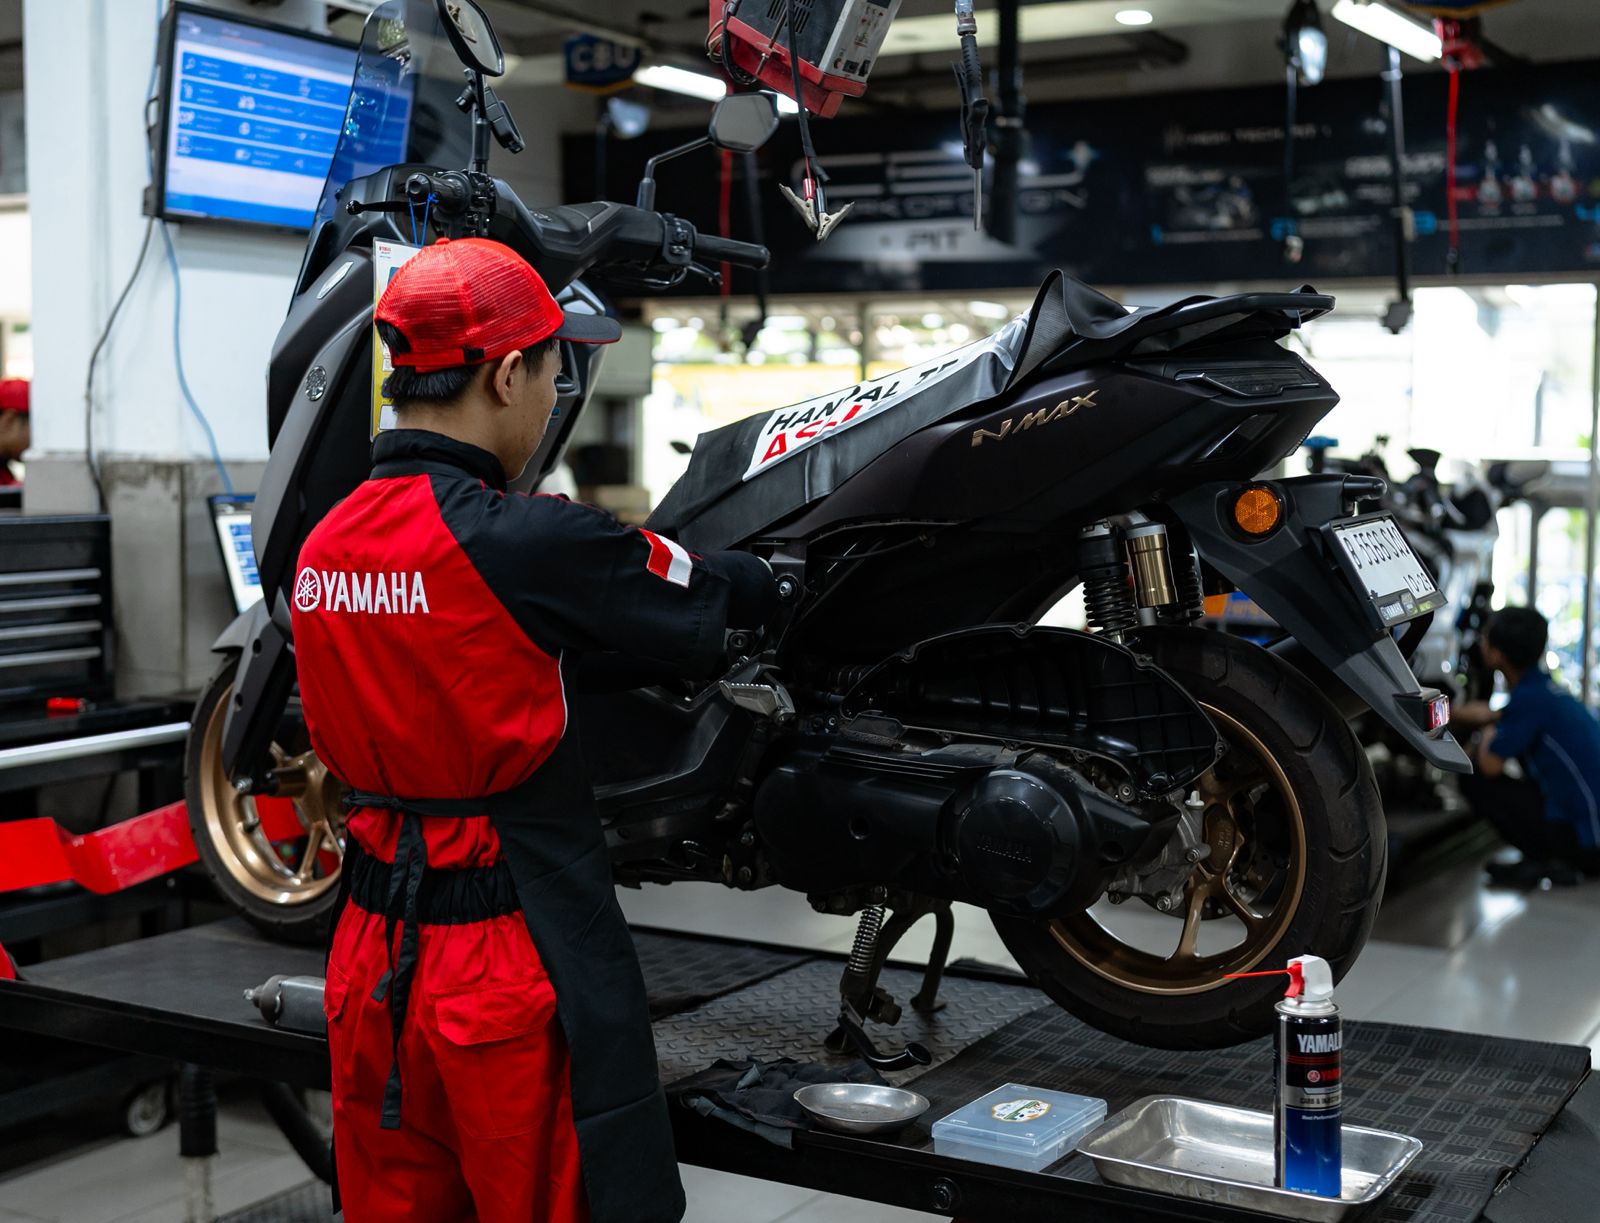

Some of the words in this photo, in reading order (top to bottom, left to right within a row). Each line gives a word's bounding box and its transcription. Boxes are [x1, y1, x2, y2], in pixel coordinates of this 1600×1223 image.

[1343, 536, 1363, 570] B
[1353, 530, 1392, 566] 5566
[322, 570, 430, 614] YAMAHA
